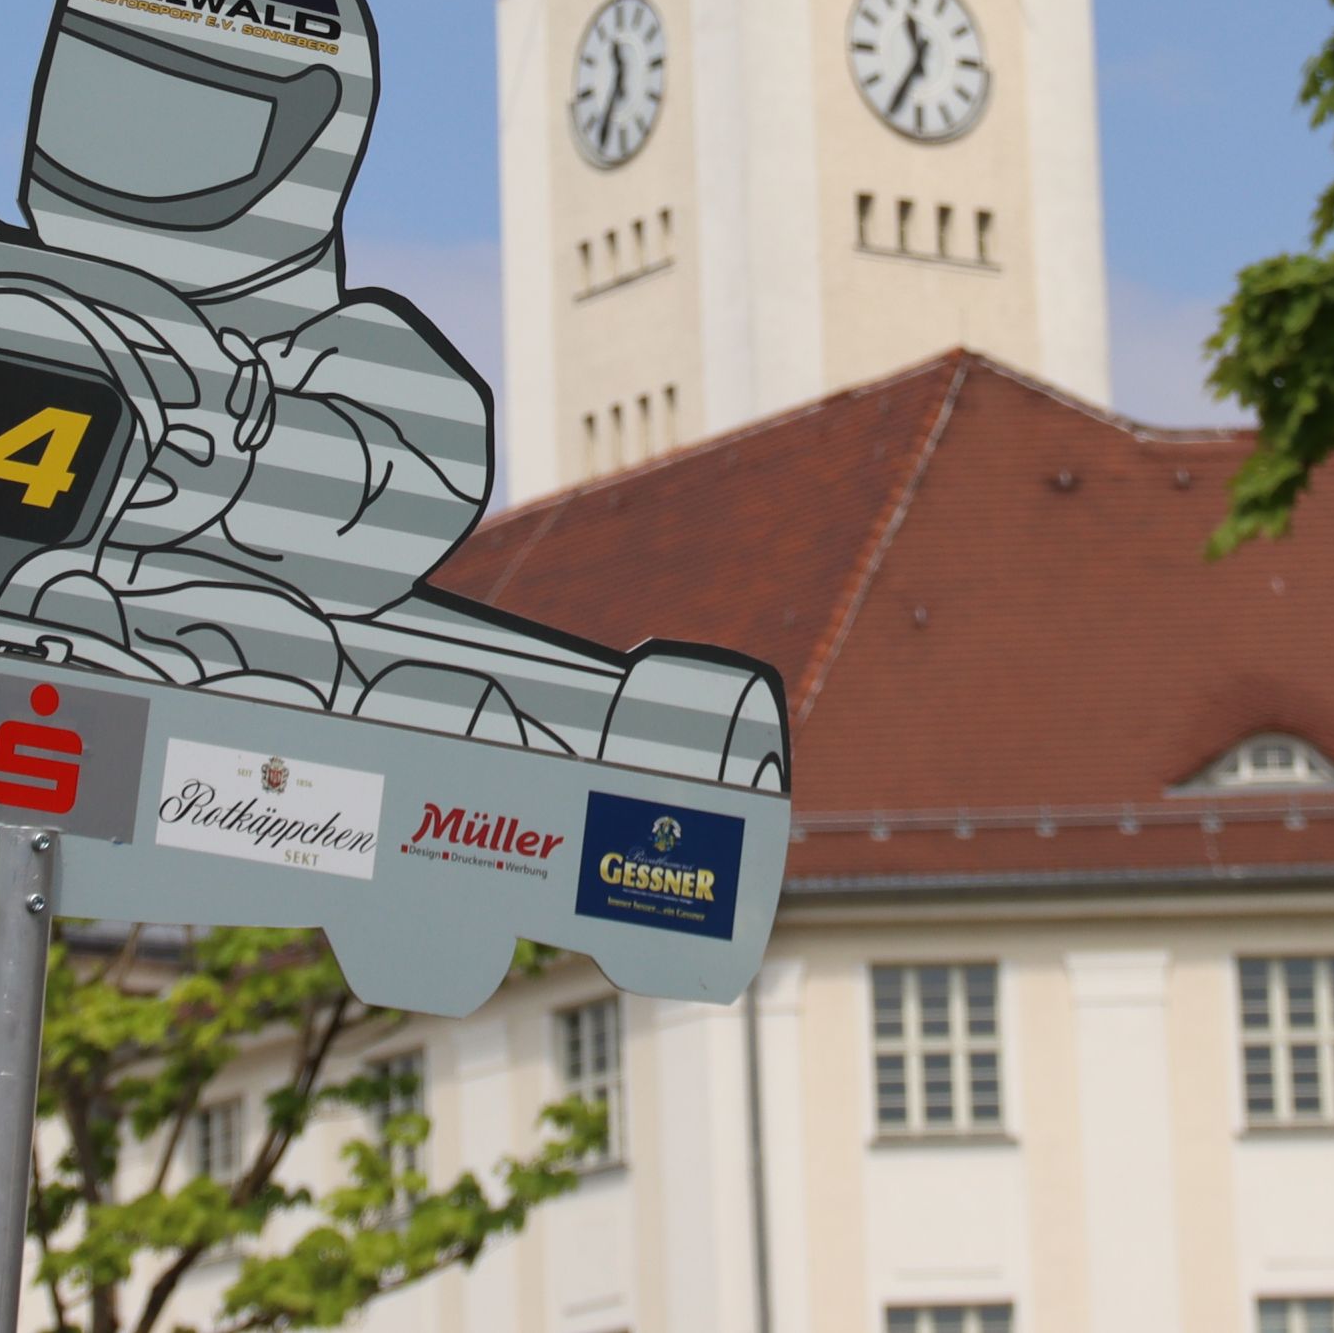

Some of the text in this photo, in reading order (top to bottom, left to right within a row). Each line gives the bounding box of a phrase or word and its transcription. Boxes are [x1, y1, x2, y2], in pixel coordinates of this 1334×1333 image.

[205, 17, 237, 33] E.V.
[241, 23, 340, 55] SONNEBERG
[158, 778, 378, 854] Rotkäppchen
[411, 802, 565, 859] Müller
[284, 849, 321, 867] SEKT
[408, 845, 549, 880] Design Druckerei Werbung
[599, 851, 715, 902] GESSNER
